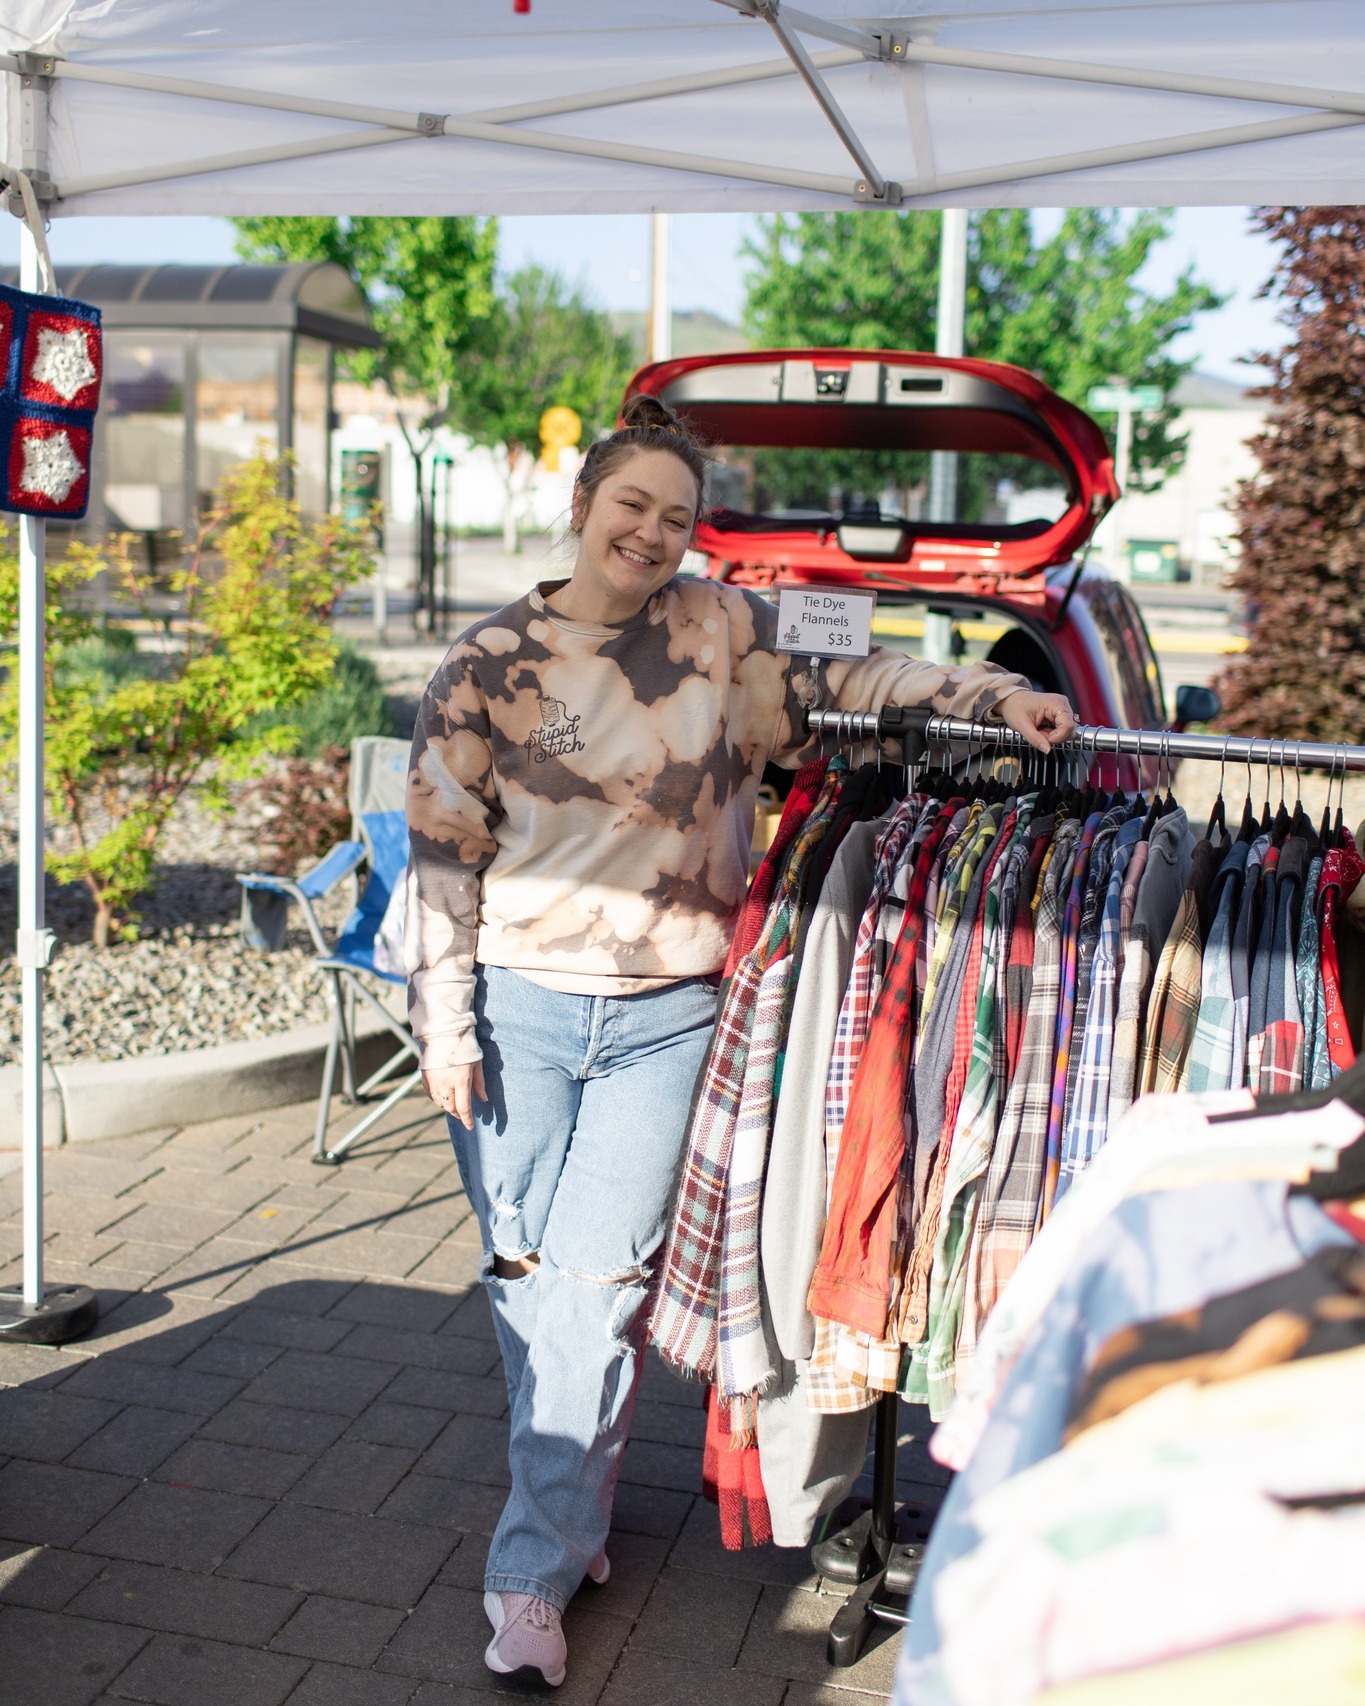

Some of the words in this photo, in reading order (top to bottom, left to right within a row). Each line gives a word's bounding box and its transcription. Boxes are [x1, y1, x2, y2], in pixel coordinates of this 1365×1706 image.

[803, 596, 820, 607] Tie
[823, 598, 846, 611] Dye
[801, 613, 849, 627] Flannels
[828, 632, 852, 647] $35
[524, 715, 580, 749] Stupid
[534, 734, 586, 763] Stitch
